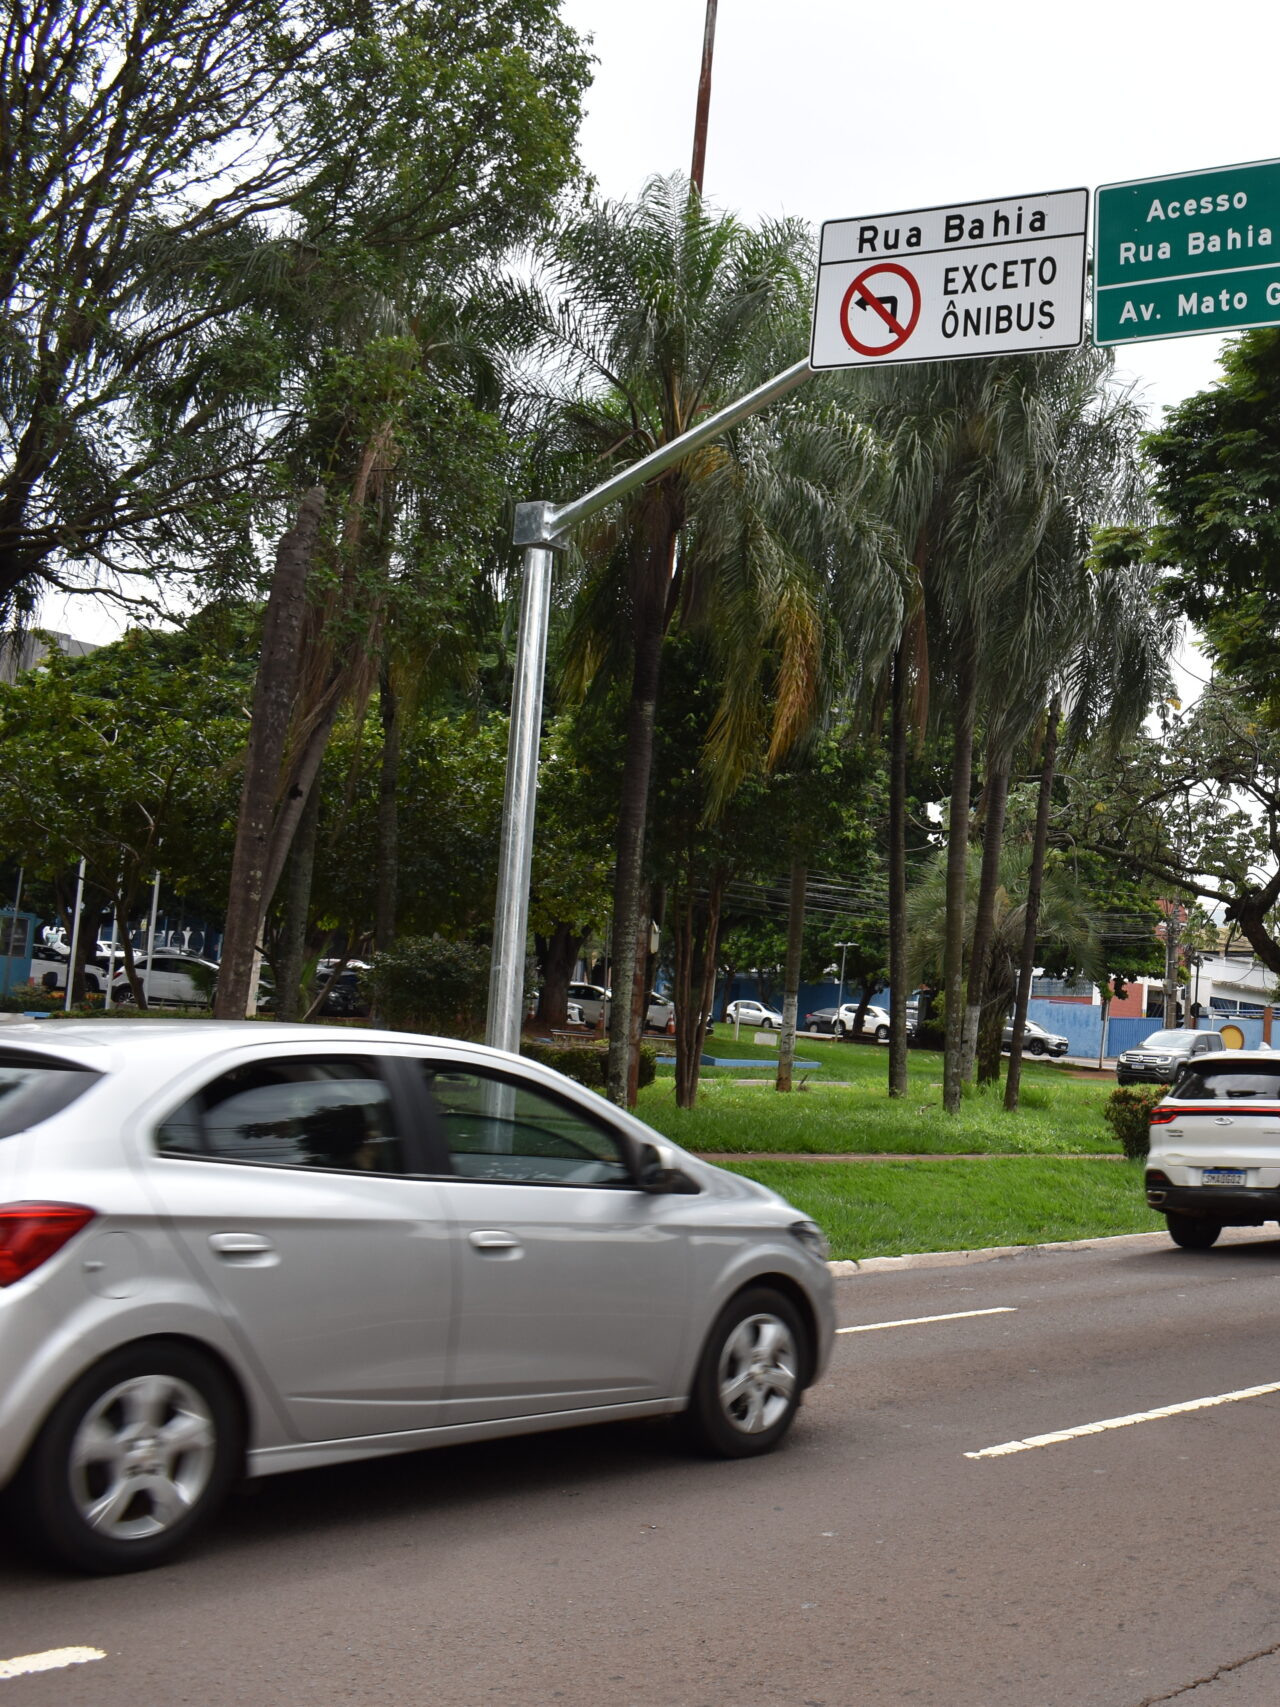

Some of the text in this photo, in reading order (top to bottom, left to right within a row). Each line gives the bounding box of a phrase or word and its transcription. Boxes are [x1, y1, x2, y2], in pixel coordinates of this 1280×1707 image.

[1146, 191, 1248, 223] Acesso
[858, 206, 1047, 254] Rua Bahia
[1119, 224, 1272, 265] Rua Bahia
[943, 256, 1057, 296] EXCETO
[941, 300, 1055, 339] ÔNIBUS
[1119, 301, 1161, 324] Av.
[1177, 289, 1248, 317] Mato
